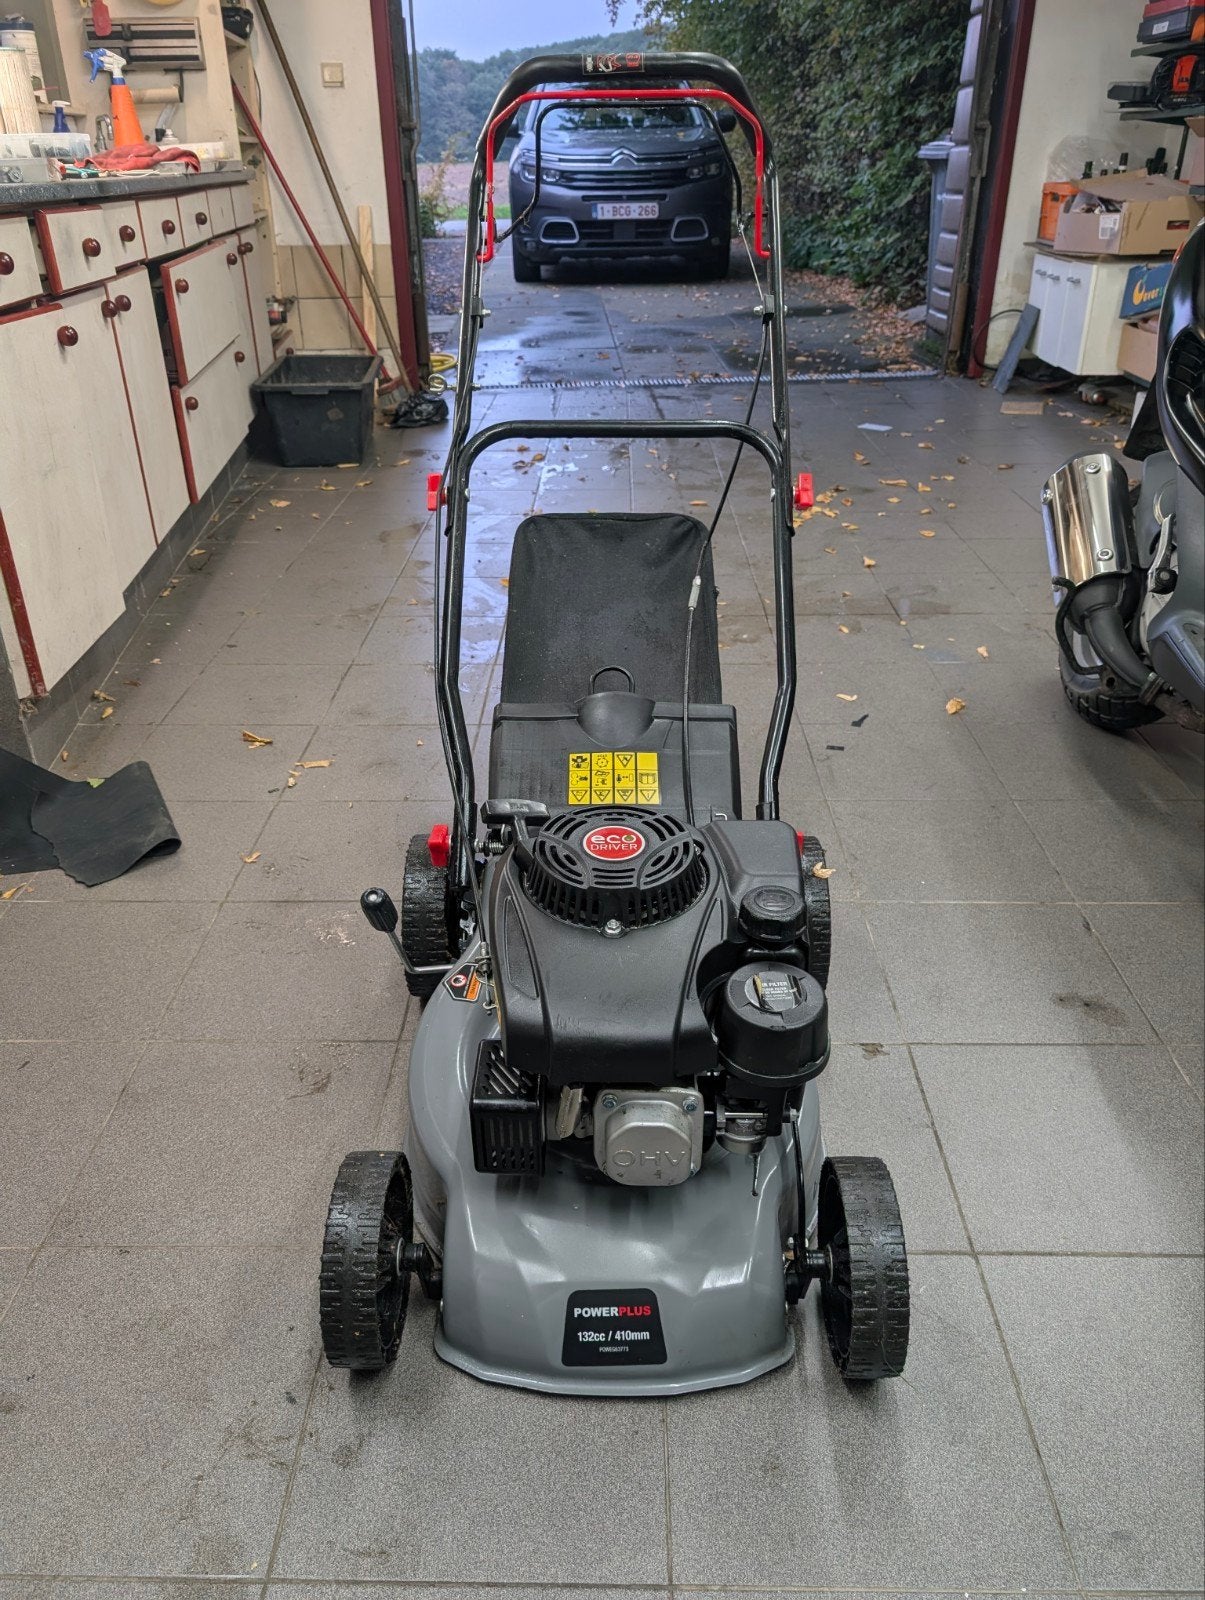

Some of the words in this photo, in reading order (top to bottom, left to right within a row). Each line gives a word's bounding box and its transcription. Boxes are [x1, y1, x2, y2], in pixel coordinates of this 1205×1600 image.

[600, 205, 657, 217] 1-BCG-266
[591, 834, 637, 844] eco
[590, 843, 638, 851] DRIVER
[612, 1148, 686, 1168] OHV
[573, 1305, 652, 1318] POWERPLUS
[577, 1331, 606, 1342] 132cc
[607, 1330, 613, 1342] /
[614, 1330, 650, 1341] 410mm
